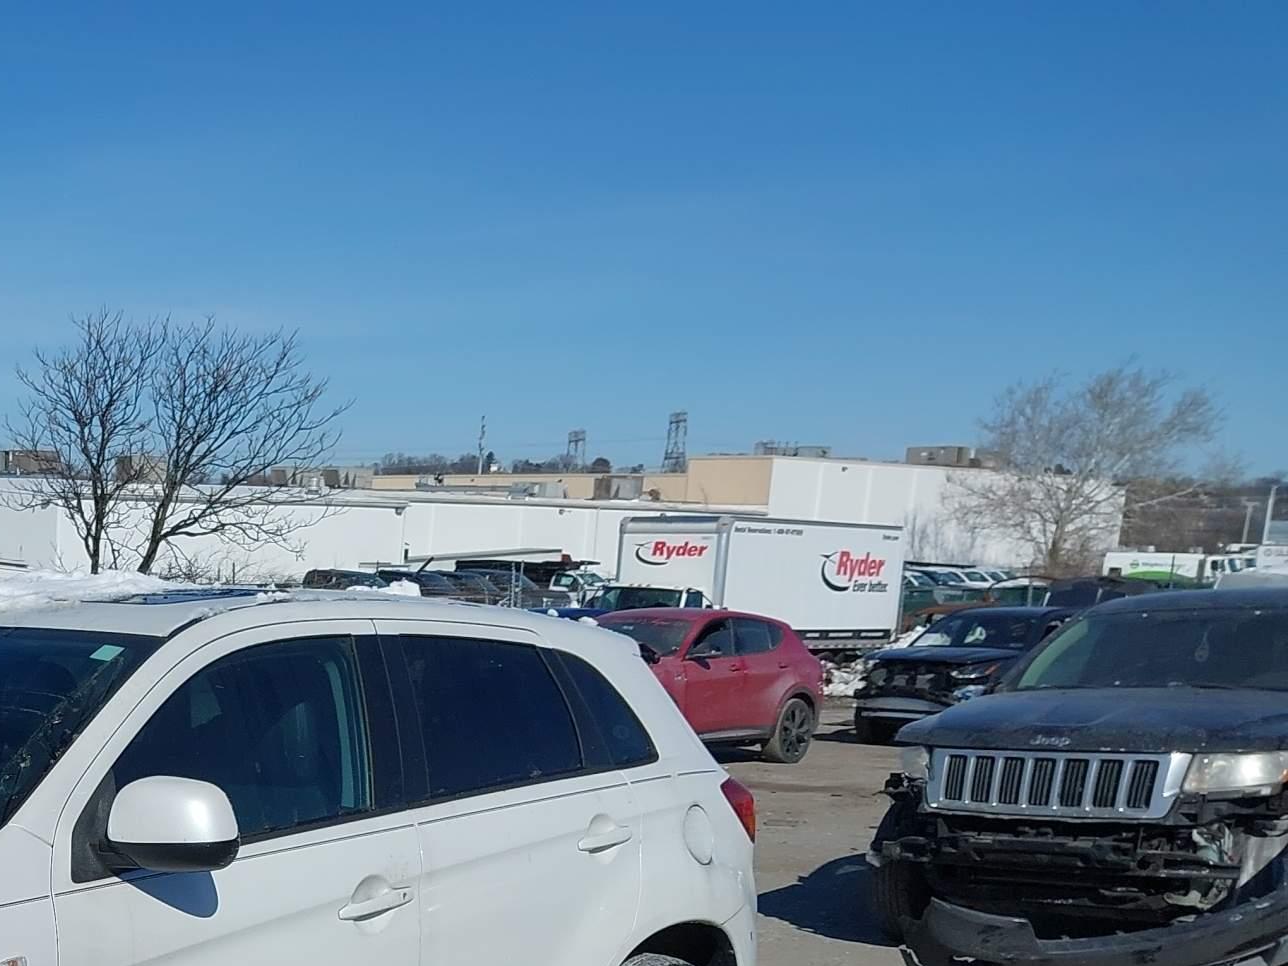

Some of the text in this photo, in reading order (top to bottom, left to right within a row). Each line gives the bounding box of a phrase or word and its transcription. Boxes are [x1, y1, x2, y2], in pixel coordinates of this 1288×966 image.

[652, 541, 708, 560] Ryder
[836, 551, 885, 582] Ryder
[1030, 735, 1071, 747] Jeep
